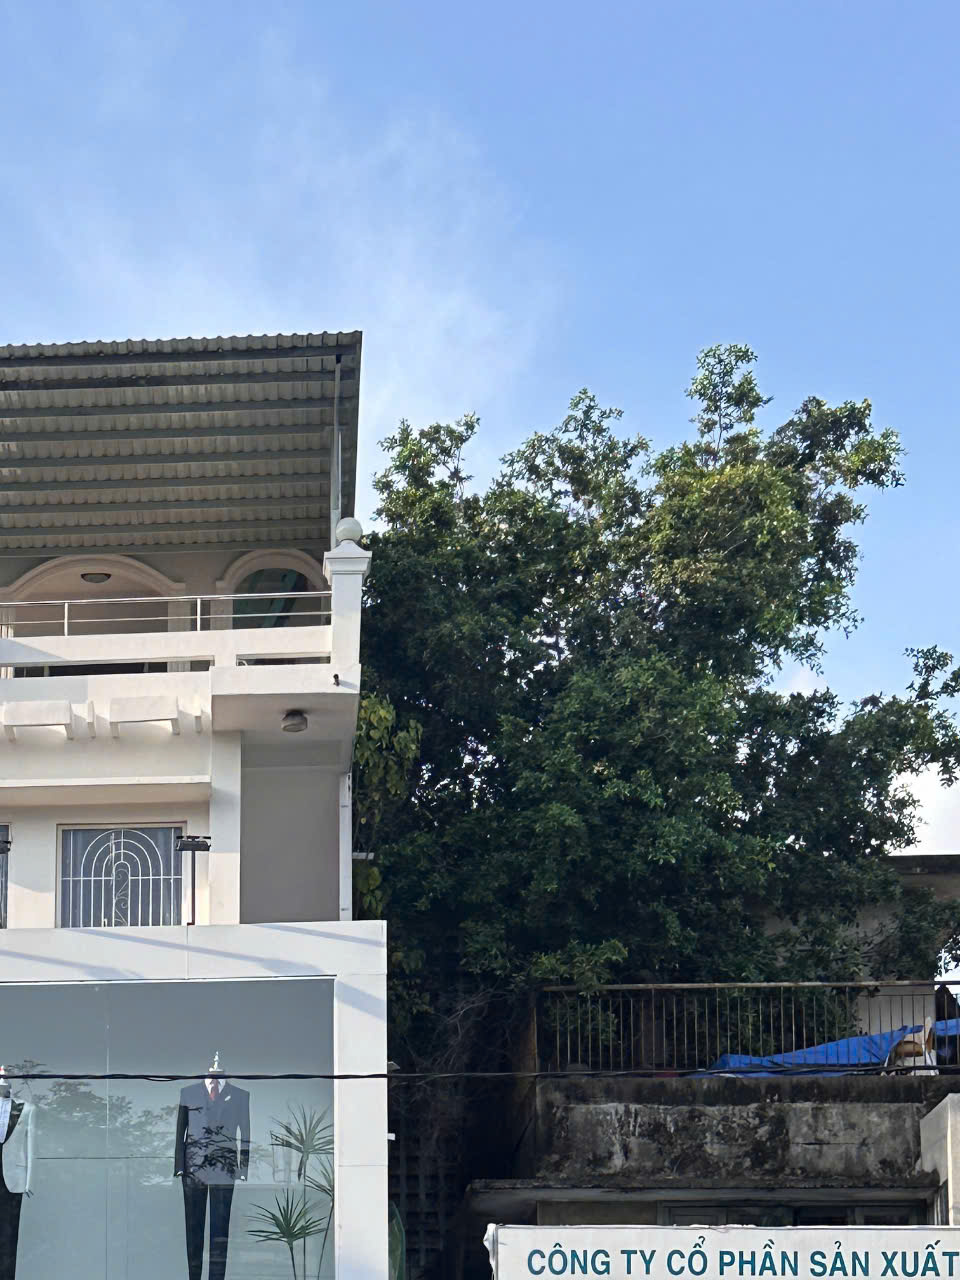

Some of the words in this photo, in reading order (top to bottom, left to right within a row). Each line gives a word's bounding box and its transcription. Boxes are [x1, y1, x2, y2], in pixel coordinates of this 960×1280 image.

[527, 1243, 610, 1275] CÔNG
[621, 1250, 656, 1274] TY
[667, 1236, 708, 1275] CỔ
[720, 1239, 798, 1277] PHẦN
[810, 1241, 869, 1277] SẢN
[881, 1240, 960, 1277] XUẤT
